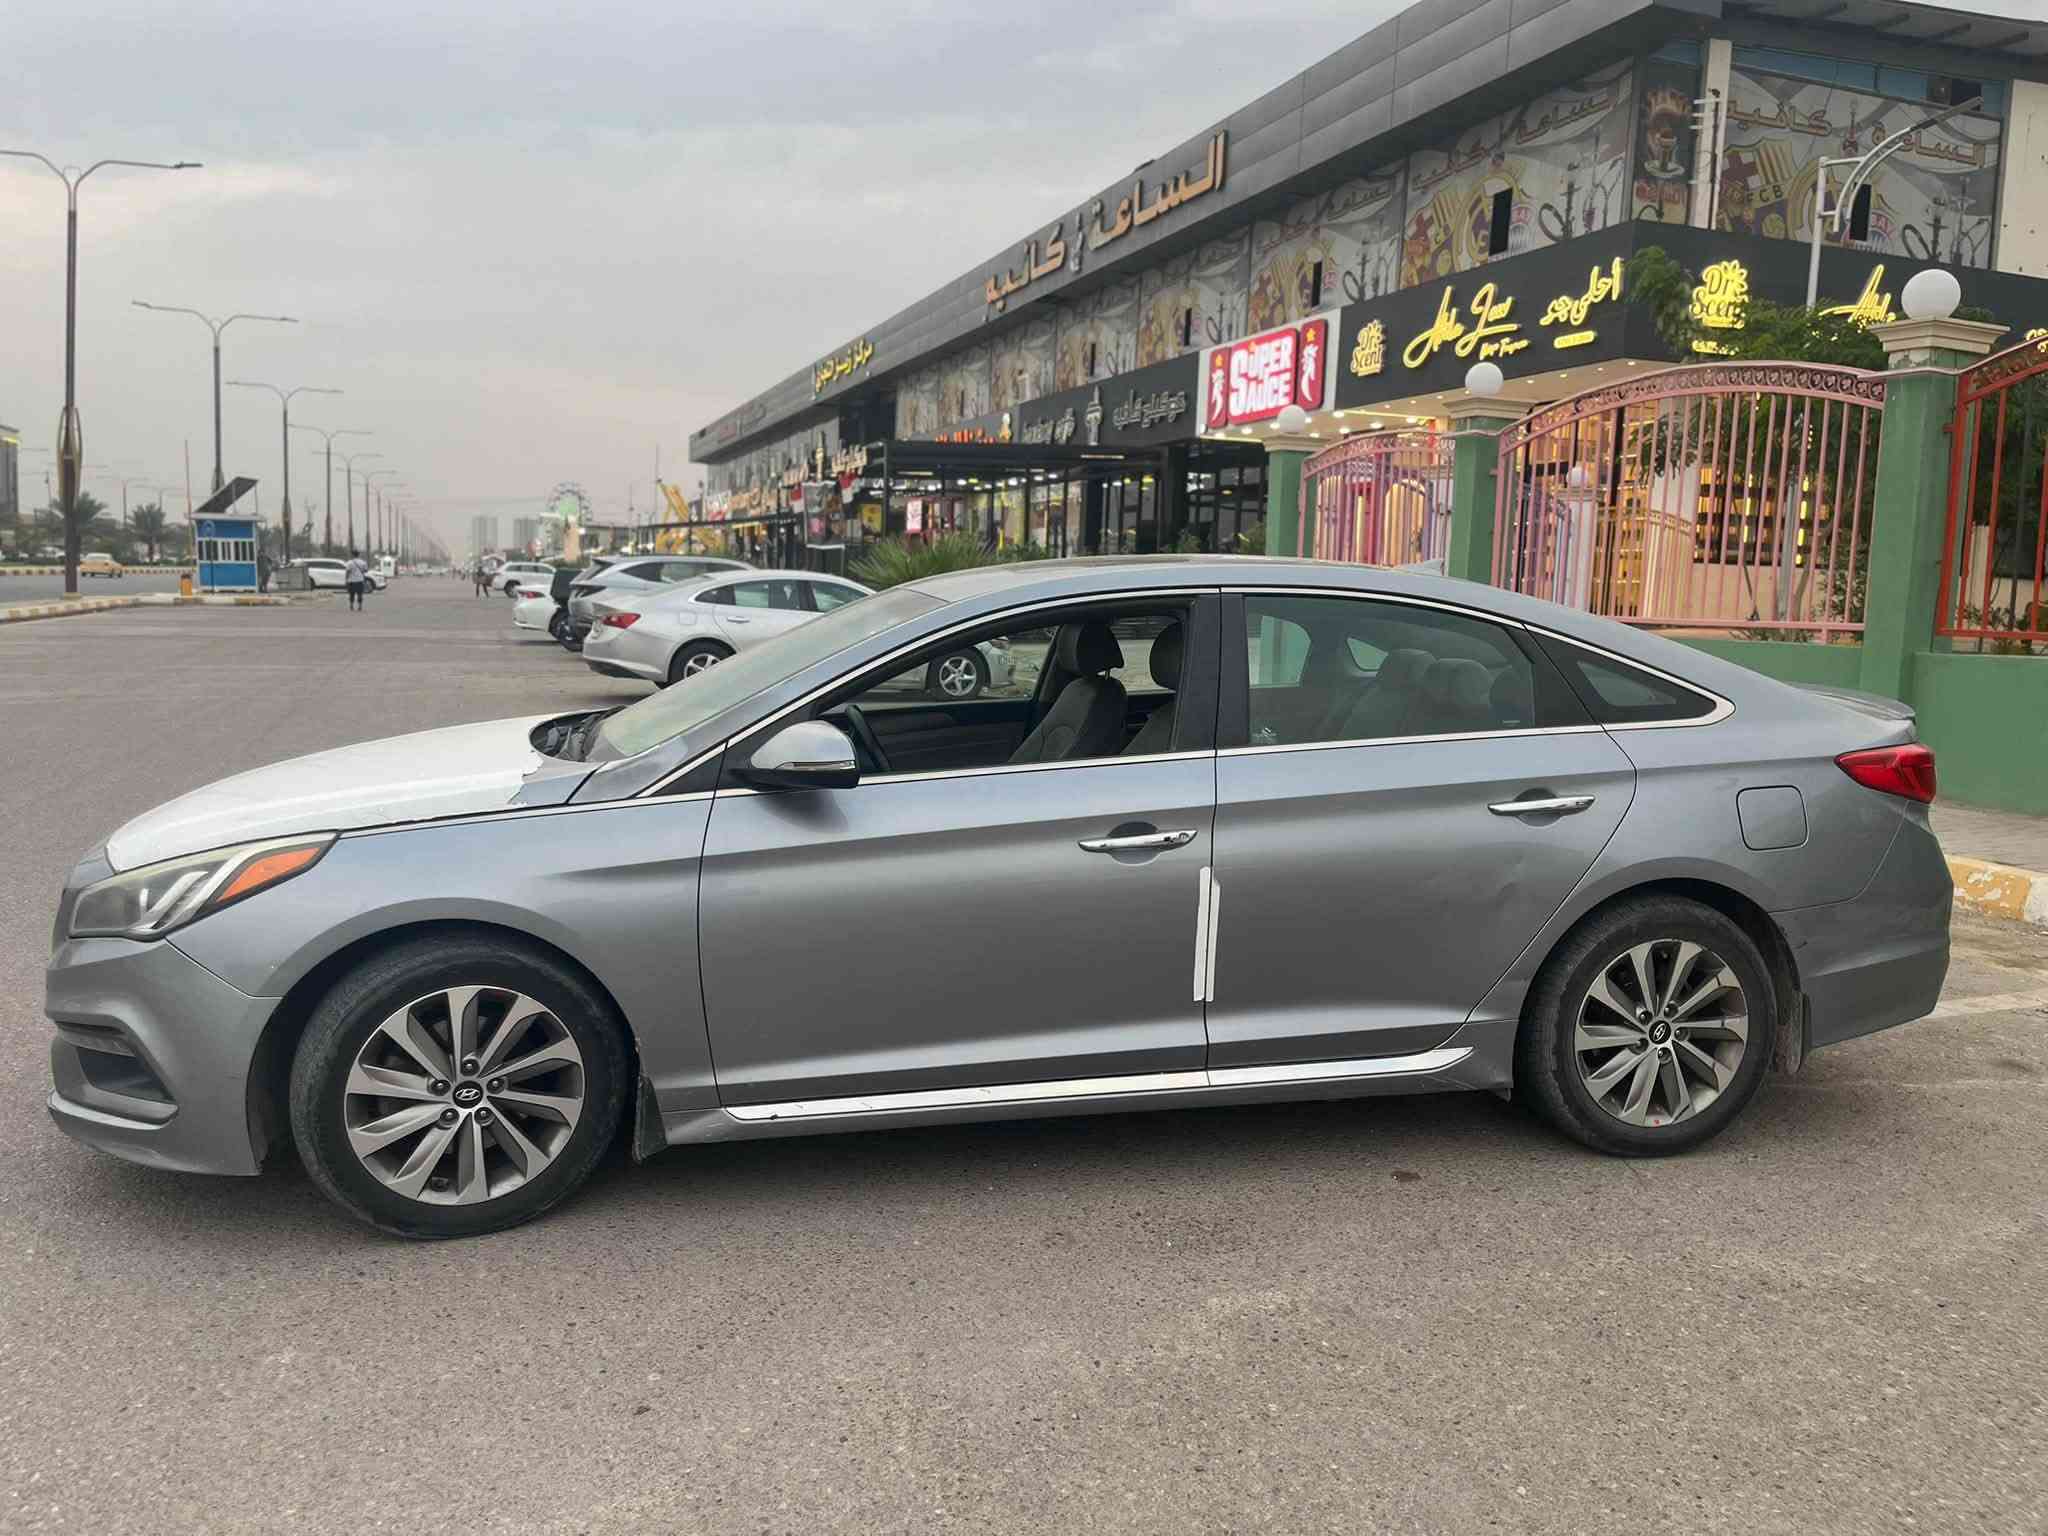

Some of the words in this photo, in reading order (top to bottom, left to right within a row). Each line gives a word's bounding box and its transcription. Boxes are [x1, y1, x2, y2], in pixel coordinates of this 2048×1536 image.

[1088, 128, 1228, 251] الساعة
[1229, 336, 1293, 390] SUPER
[1229, 372, 1292, 417] SAUCE
